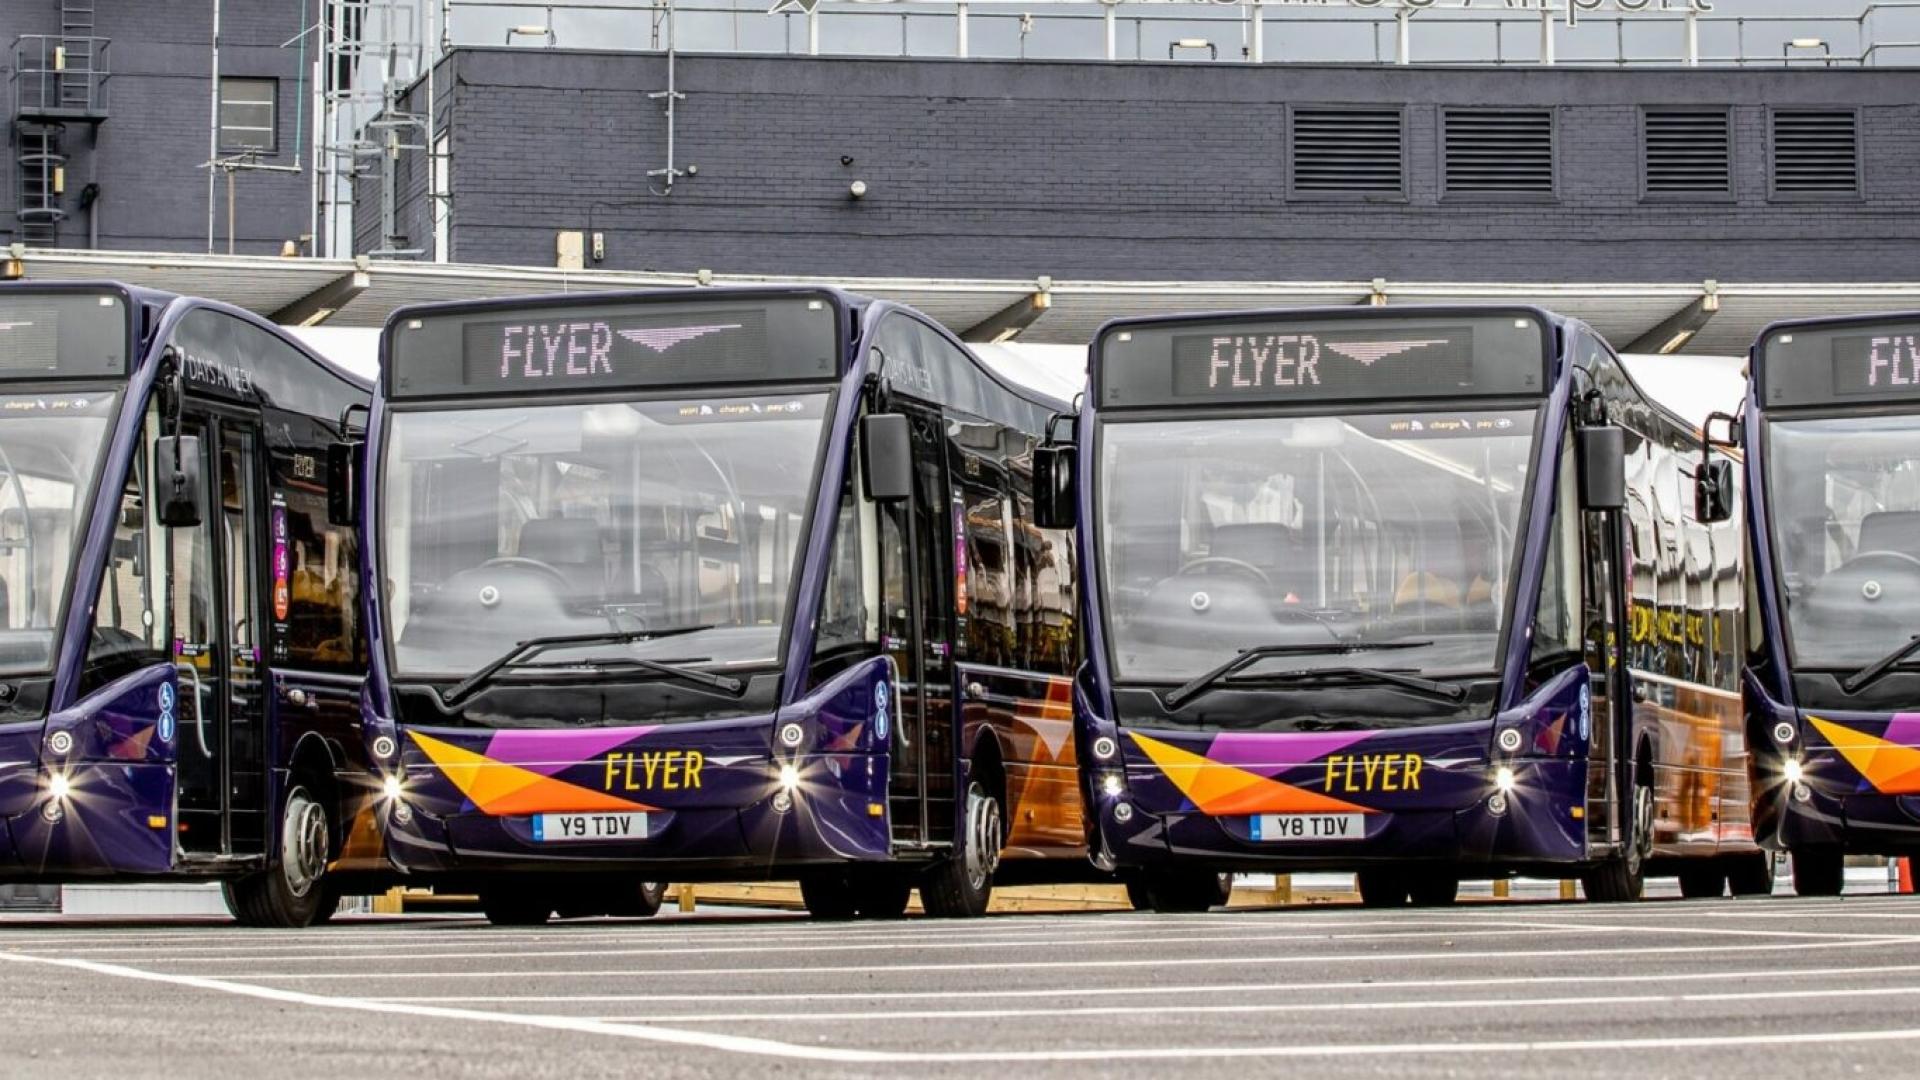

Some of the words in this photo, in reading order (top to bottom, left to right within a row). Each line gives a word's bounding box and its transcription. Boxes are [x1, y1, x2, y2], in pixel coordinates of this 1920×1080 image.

[501, 322, 613, 378] FLYER
[1209, 335, 1321, 388] FLYER
[605, 751, 703, 790] FLYER
[1325, 754, 1422, 792] FLYER
[560, 816, 586, 836] Y9
[592, 816, 631, 836] TDV
[1278, 817, 1304, 836] Y8
[1310, 817, 1348, 836] TDV
